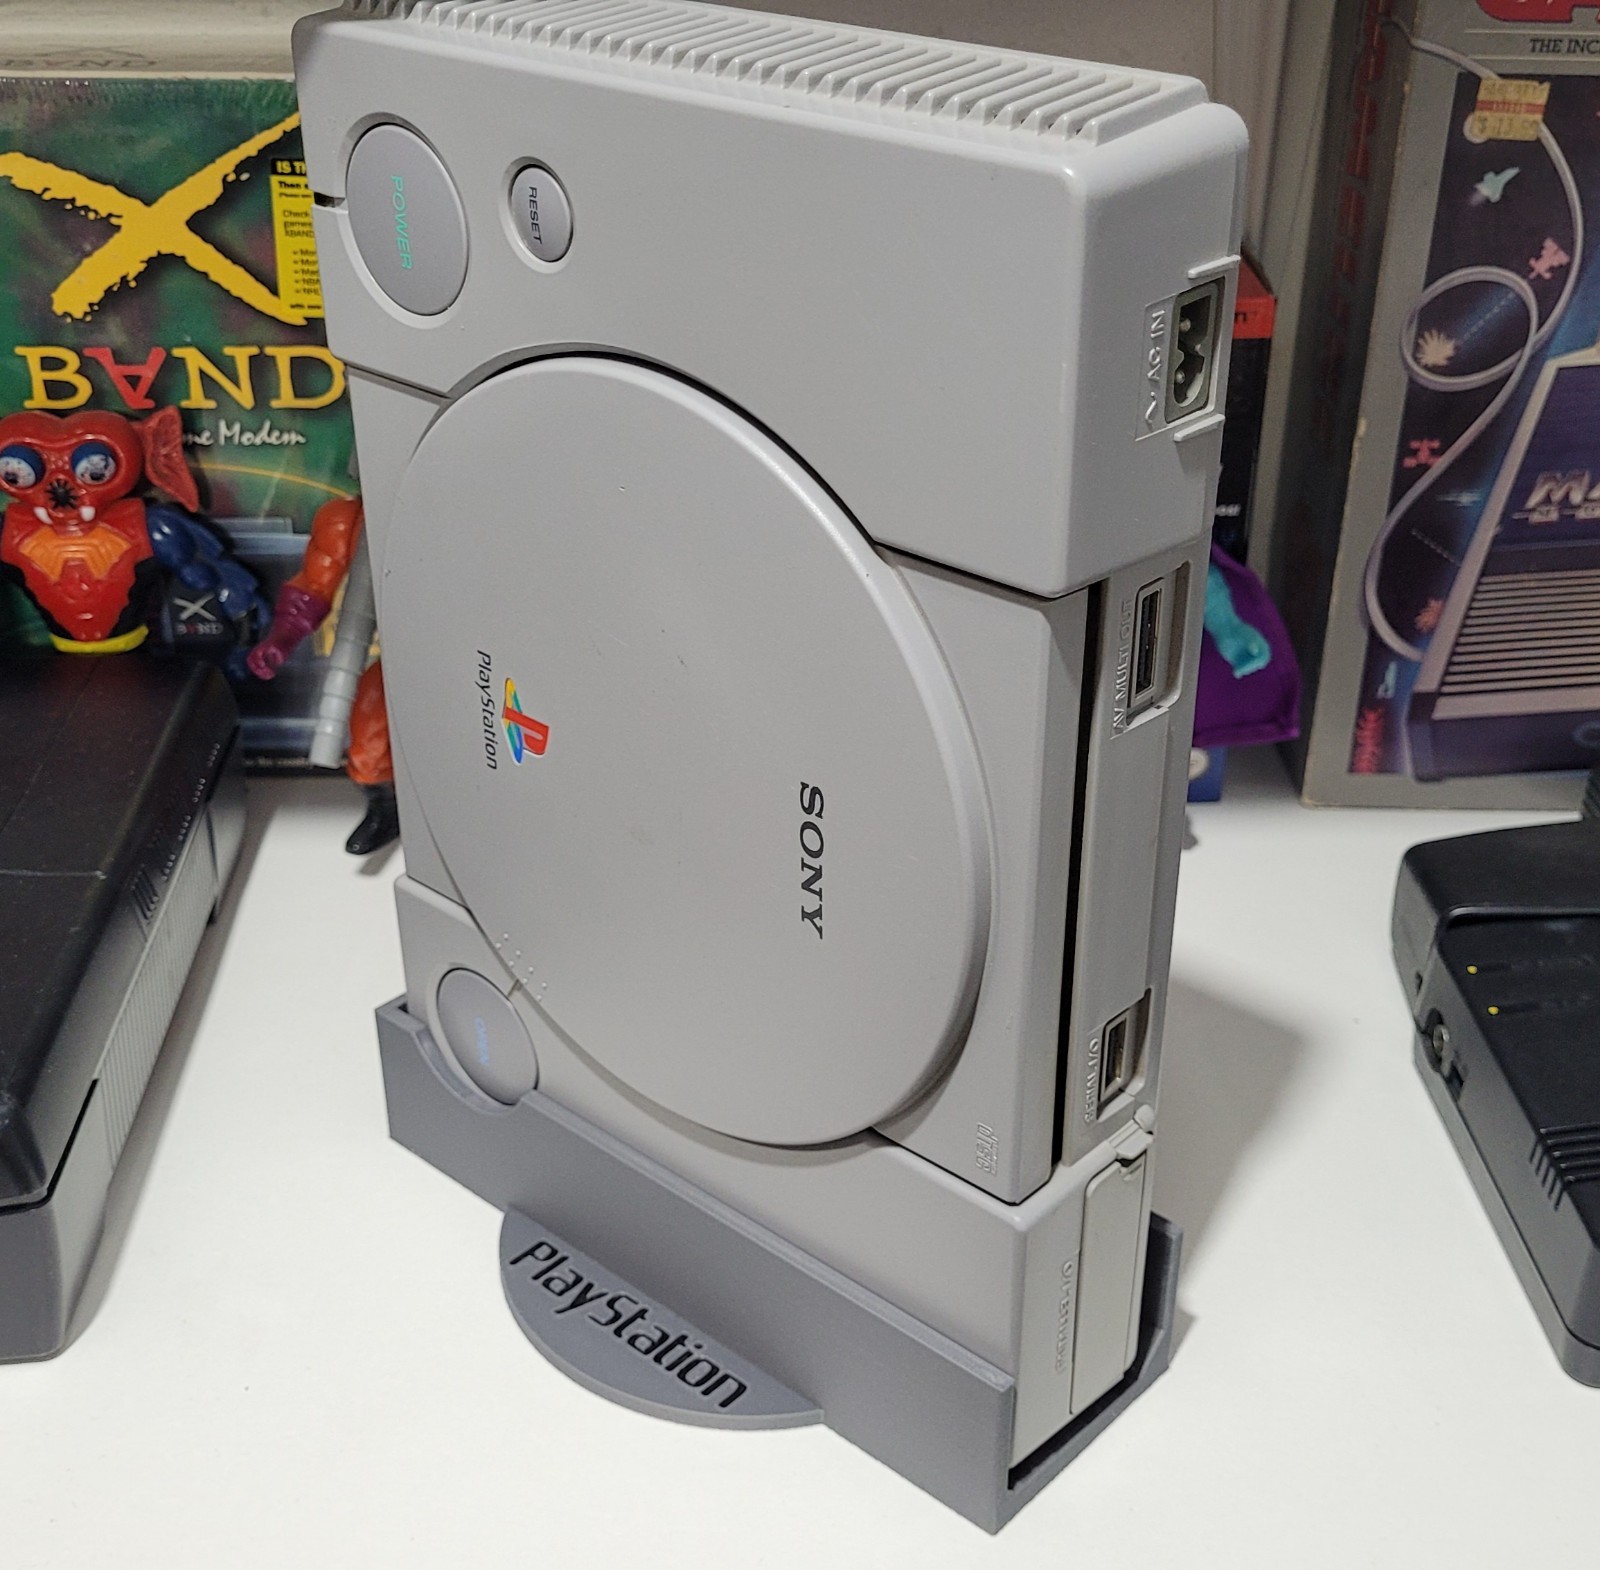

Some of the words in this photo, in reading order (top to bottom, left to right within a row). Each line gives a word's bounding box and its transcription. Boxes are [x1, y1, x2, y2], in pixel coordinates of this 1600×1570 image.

[1529, 38, 1562, 53] THE
[276, 160, 292, 174] IS
[391, 175, 413, 269] POWER
[528, 186, 543, 245] RESET
[1151, 310, 1165, 338] IN
[15, 345, 346, 410] BAND
[219, 418, 306, 446] Modem
[1115, 643, 1128, 701] MULTI
[475, 649, 499, 771] PlayStation
[1113, 707, 1125, 730] AV
[800, 781, 824, 940] SONY
[509, 1241, 748, 1409] PlayStation
